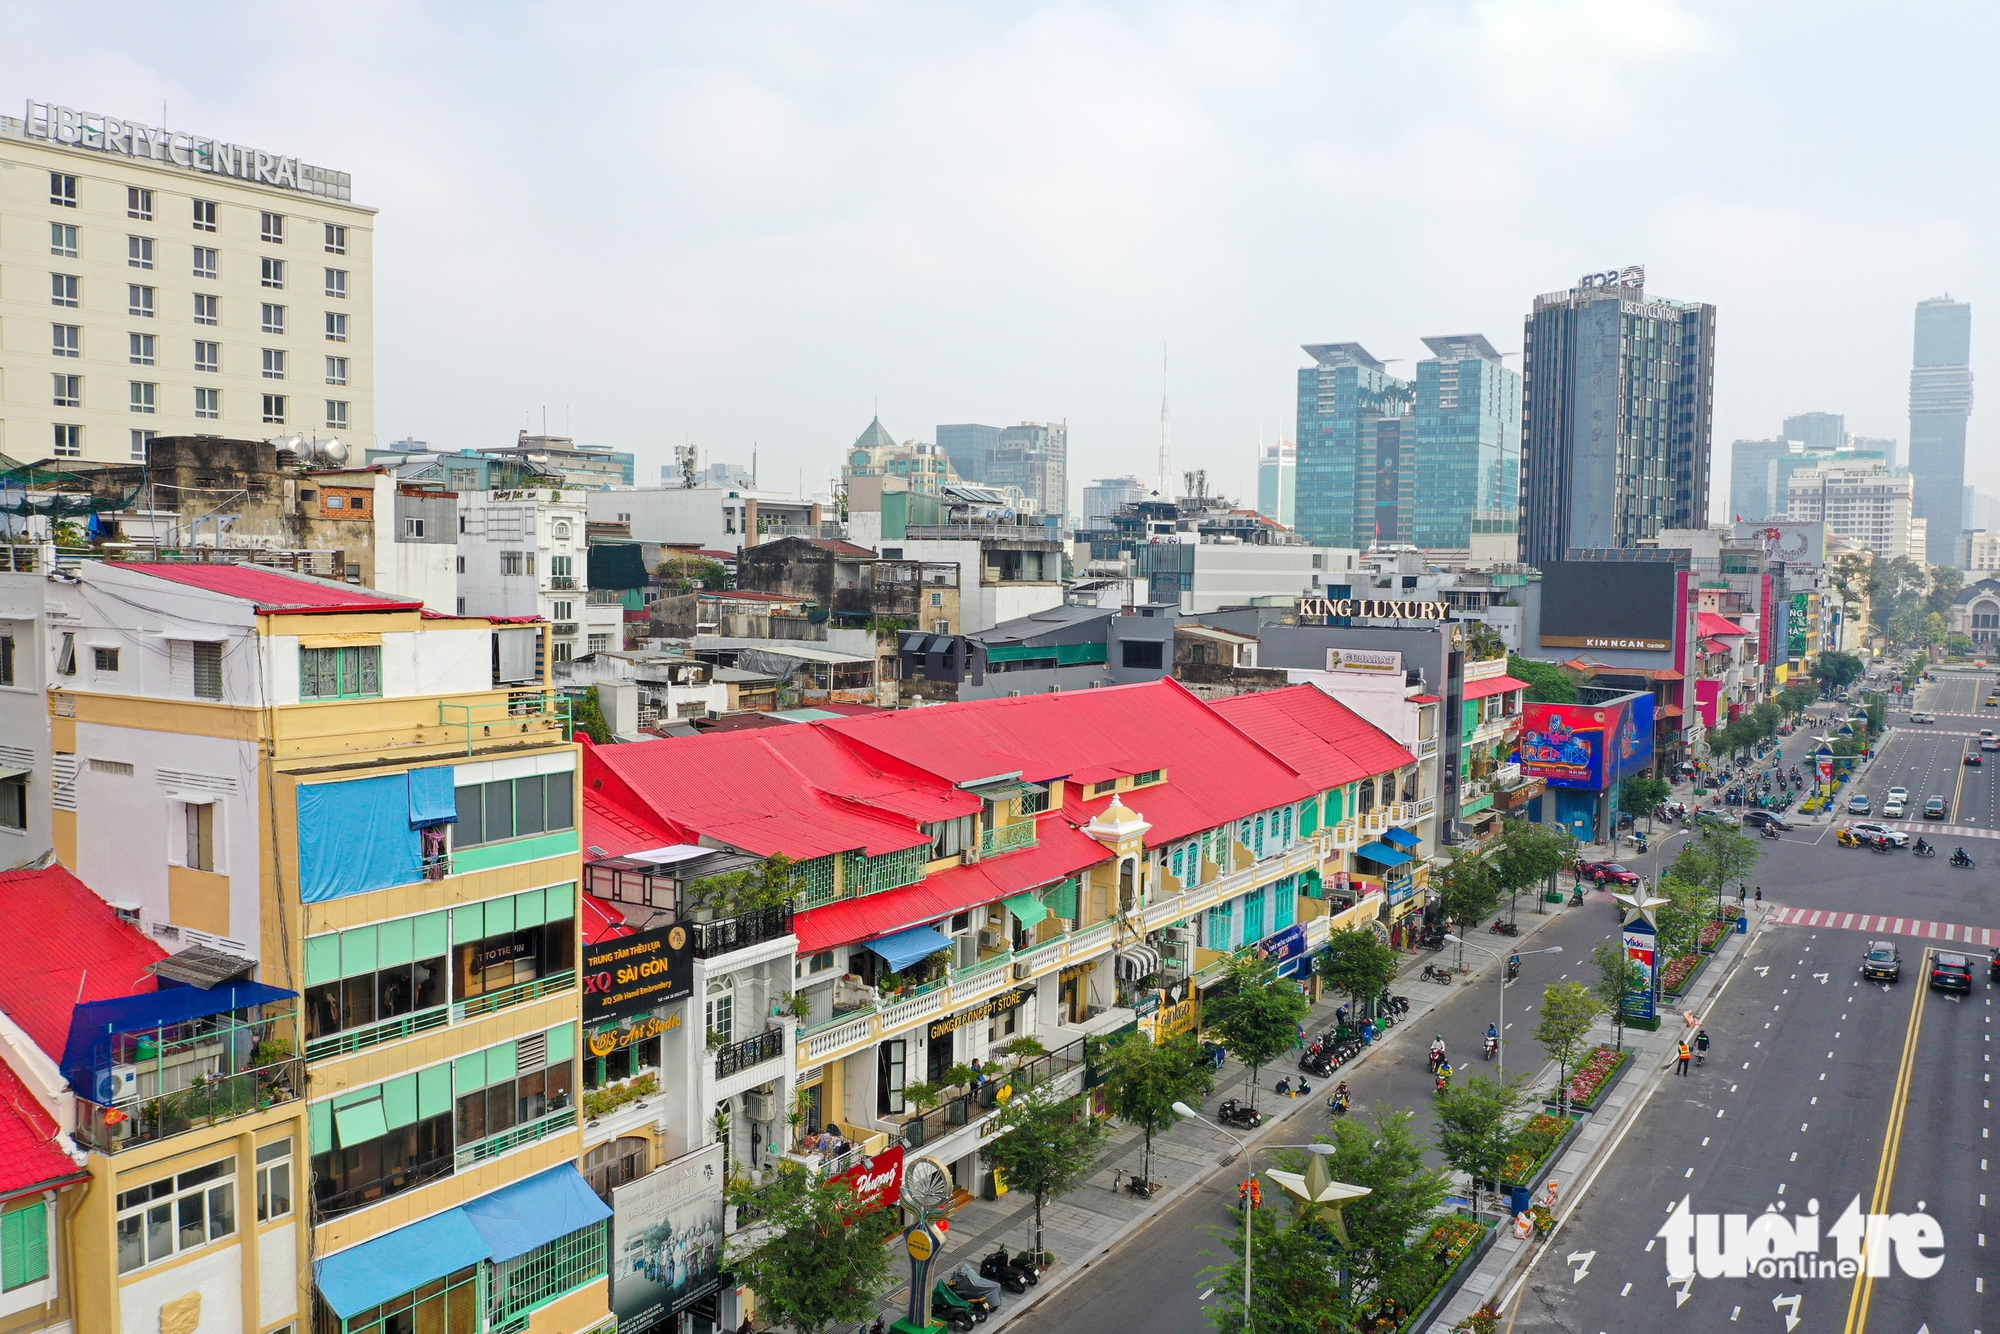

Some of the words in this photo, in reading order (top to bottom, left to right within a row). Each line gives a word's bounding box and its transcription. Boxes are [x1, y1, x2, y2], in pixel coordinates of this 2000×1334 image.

[1299, 599, 1352, 617] KING
[1359, 600, 1450, 620] LUXURY
[1586, 639, 1608, 647] KIM
[1344, 653, 1395, 664] GUJARAT
[588, 953, 613, 967] TRUNG
[583, 971, 612, 995] XQ
[616, 964, 638, 985] SÀI
[640, 956, 669, 978] GÒN
[931, 1015, 960, 1039] GINKGO
[961, 1001, 997, 1027] CONCEPT
[998, 991, 1022, 1011] STORE
[620, 1025, 645, 1047] Art
[646, 1015, 681, 1037] Studio
